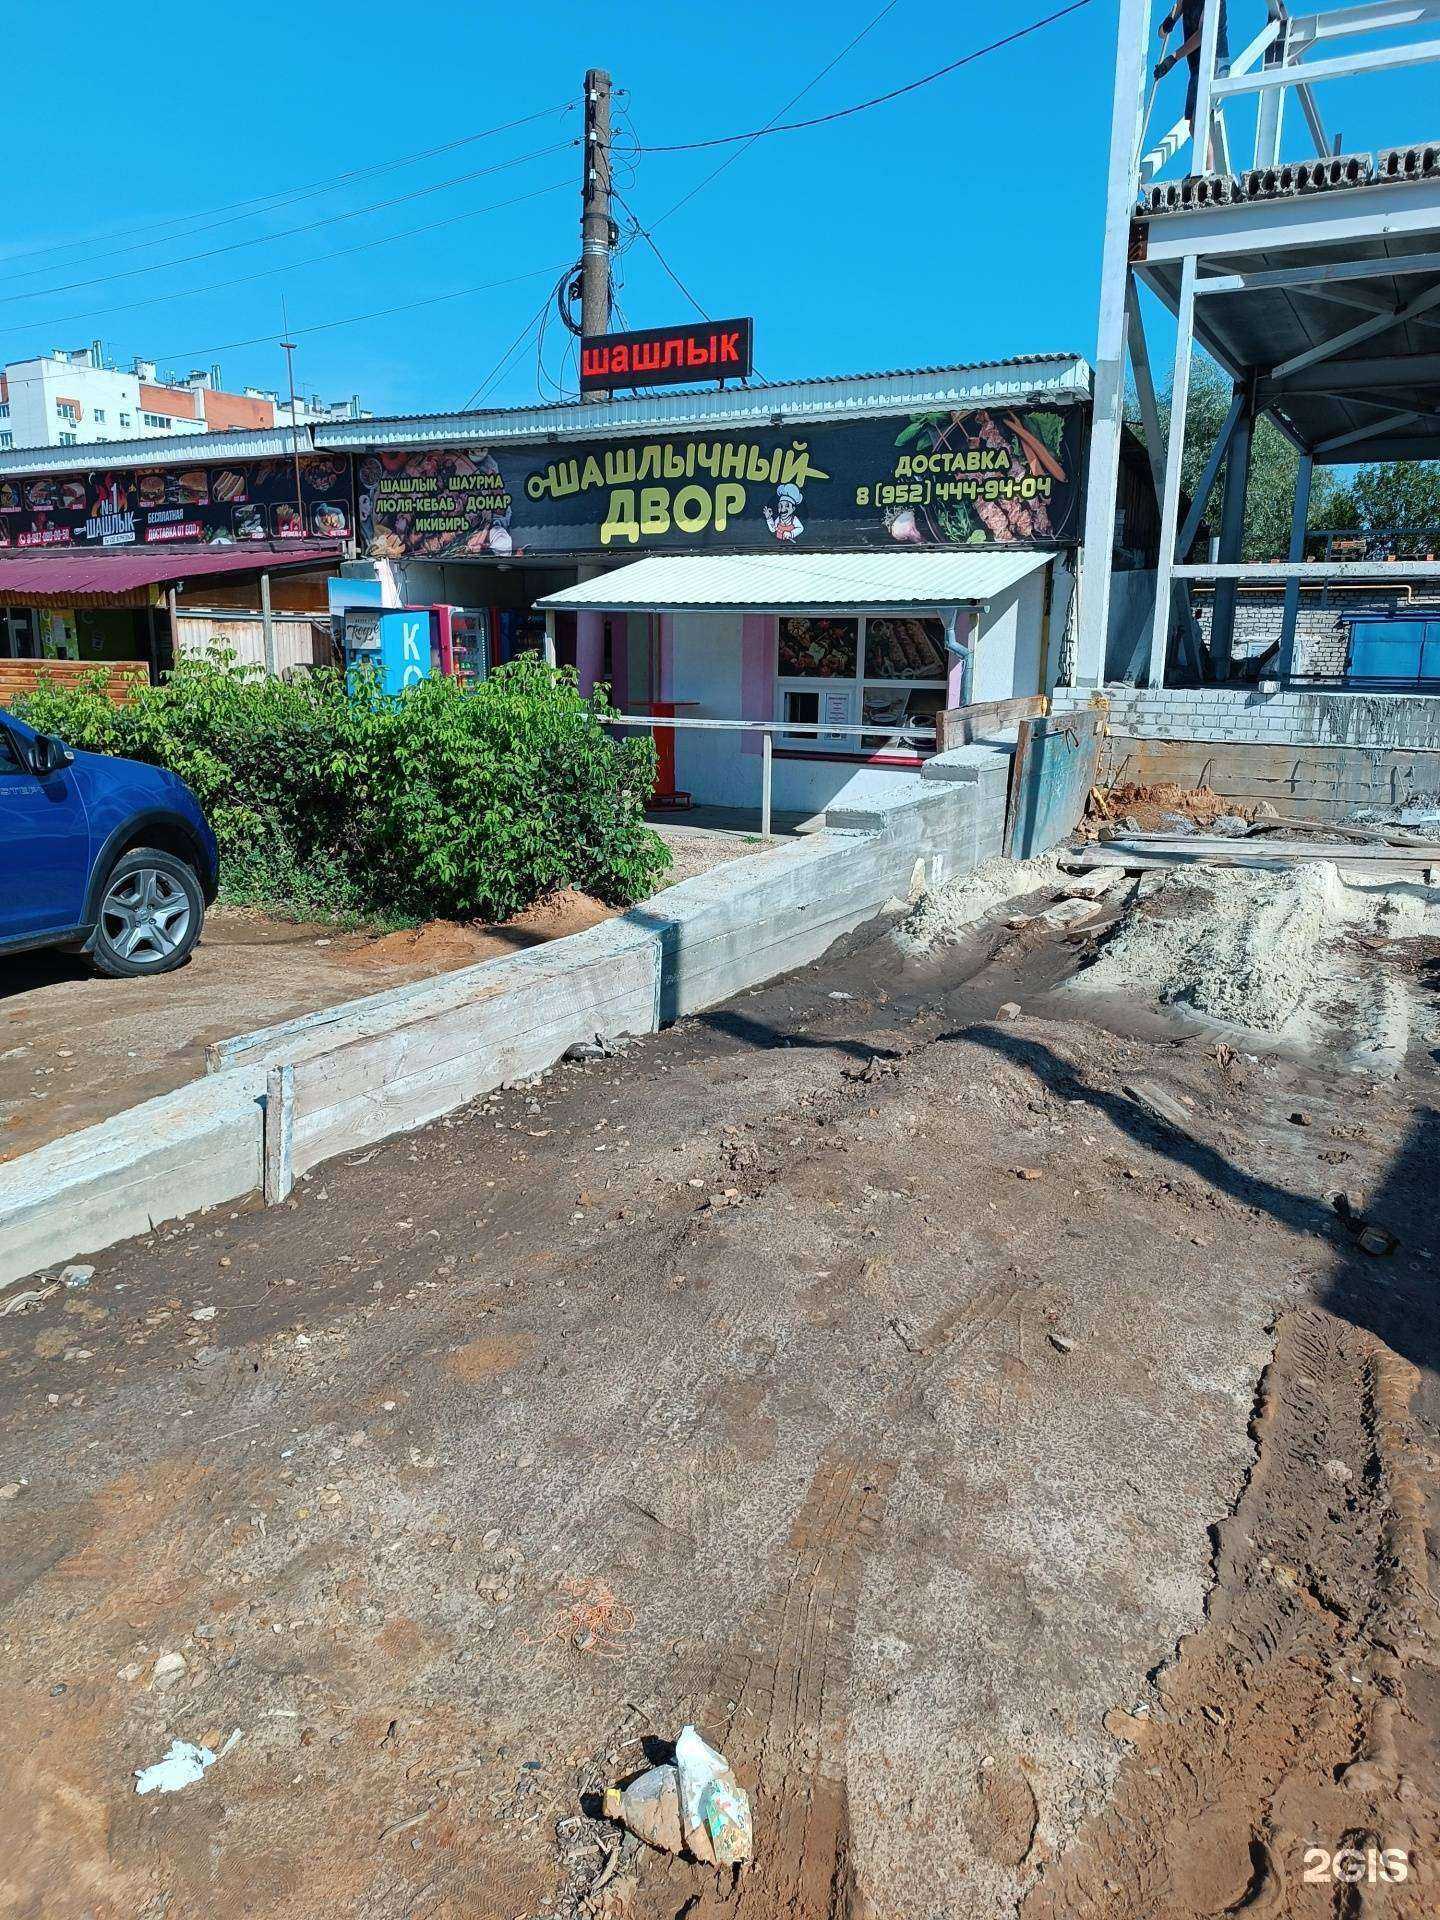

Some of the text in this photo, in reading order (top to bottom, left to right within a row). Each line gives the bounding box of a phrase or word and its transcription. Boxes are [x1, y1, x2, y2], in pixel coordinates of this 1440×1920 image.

[549, 441, 810, 498] ШАШЛЫЧНЫЙ
[894, 451, 1010, 478] ДОСТАВКА
[380, 475, 504, 493] ШАШЛЫК ШАУРМА
[856, 486, 869, 505] 8
[935, 477, 1051, 501] 444-94-04
[376, 498, 455, 513] ЛЮЛЯ-КЕБАБ
[600, 482, 746, 544] ДВОР
[86, 511, 135, 539] ШАШЛЫК
